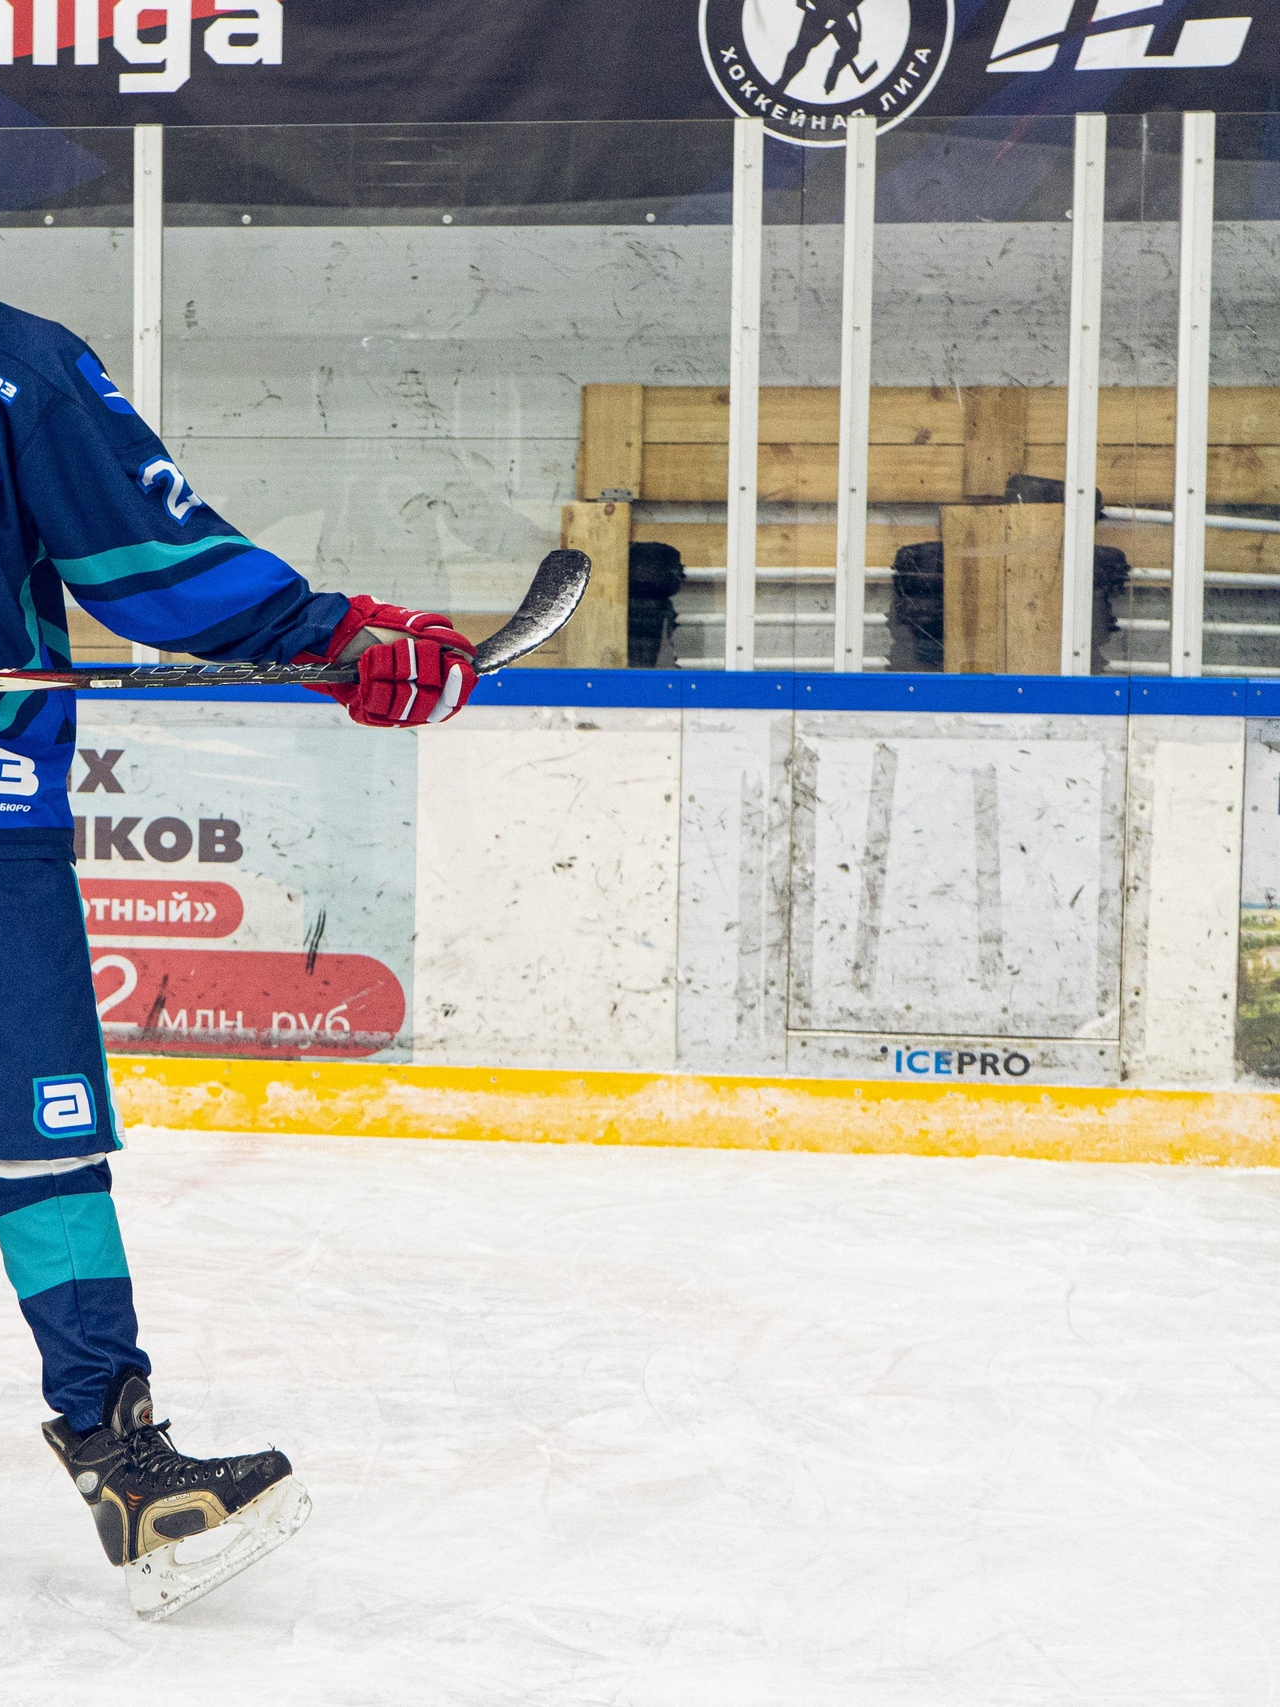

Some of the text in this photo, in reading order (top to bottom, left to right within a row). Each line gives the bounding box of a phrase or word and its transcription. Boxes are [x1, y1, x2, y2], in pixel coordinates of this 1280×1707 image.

[879, 47, 932, 111] ЛИГА
[0, 804, 32, 813] БЮРО
[895, 1050, 1031, 1077] ICEPRO
